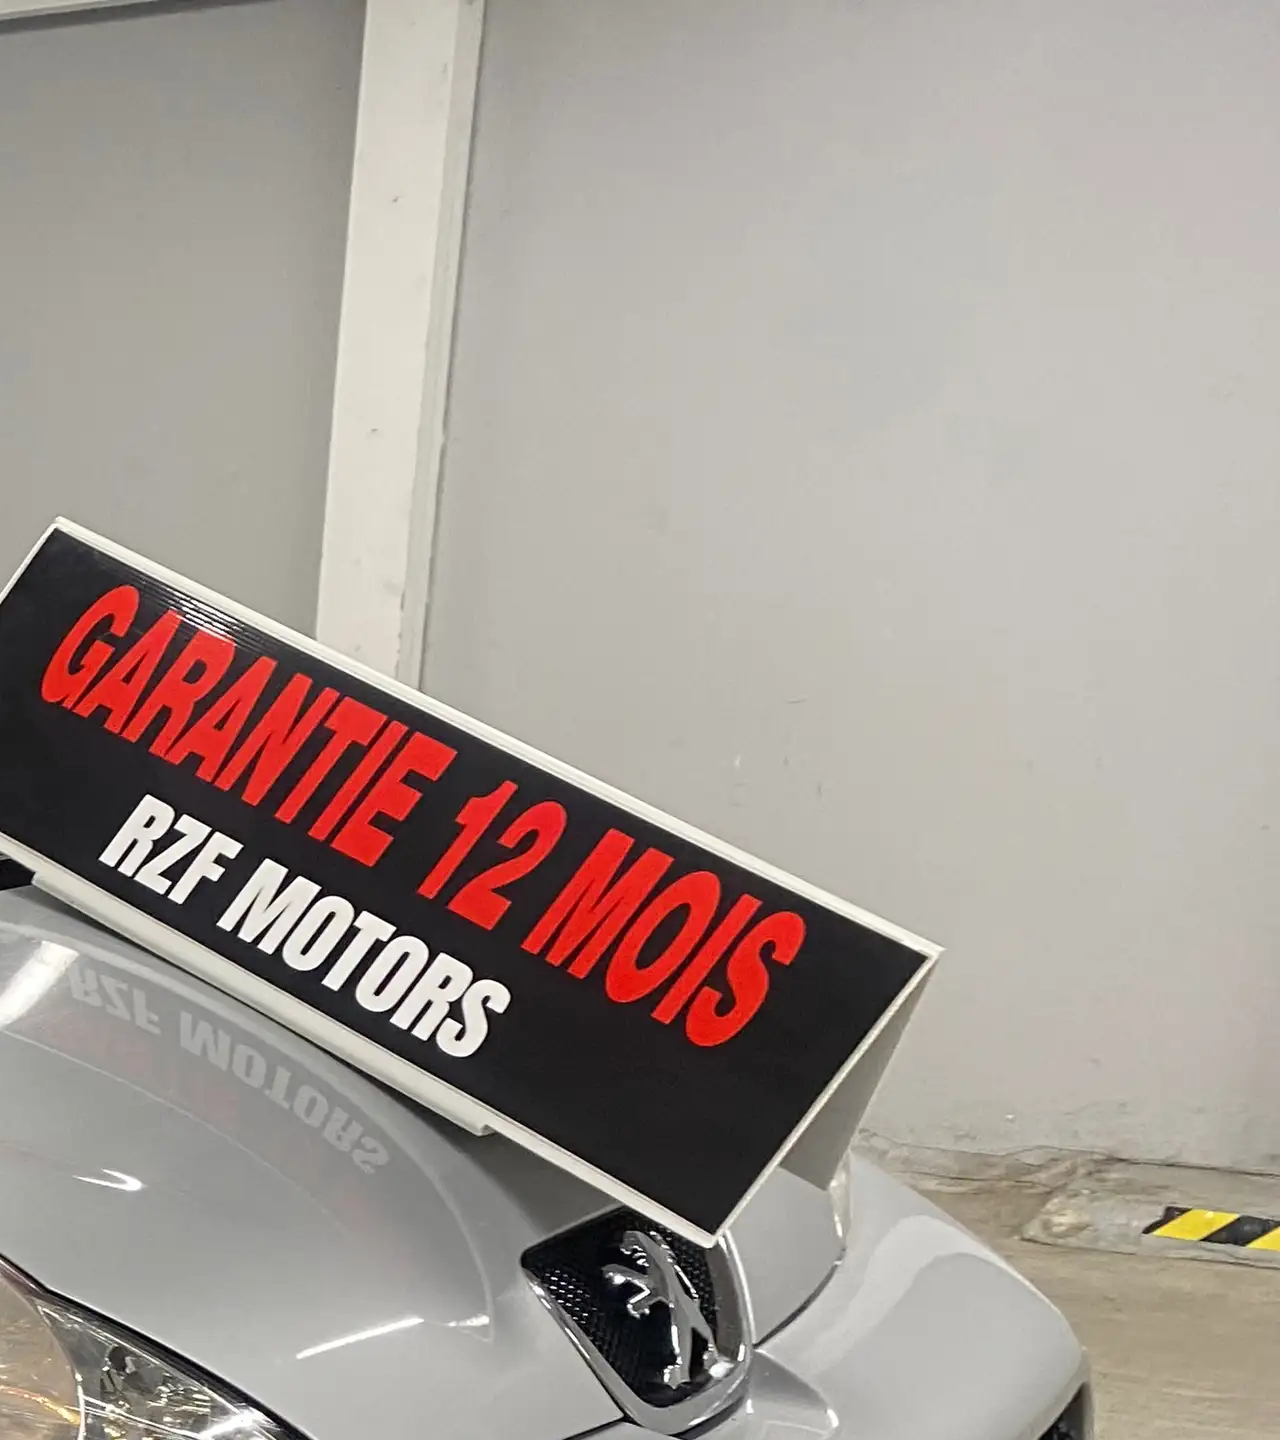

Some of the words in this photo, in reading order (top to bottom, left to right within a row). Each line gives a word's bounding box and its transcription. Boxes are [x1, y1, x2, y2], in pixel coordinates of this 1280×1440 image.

[41, 584, 458, 868] GARANTIE
[416, 779, 567, 931] 12
[520, 827, 806, 1047] MOIS
[98, 793, 245, 905] RZF
[215, 857, 511, 1058] MOTORS
